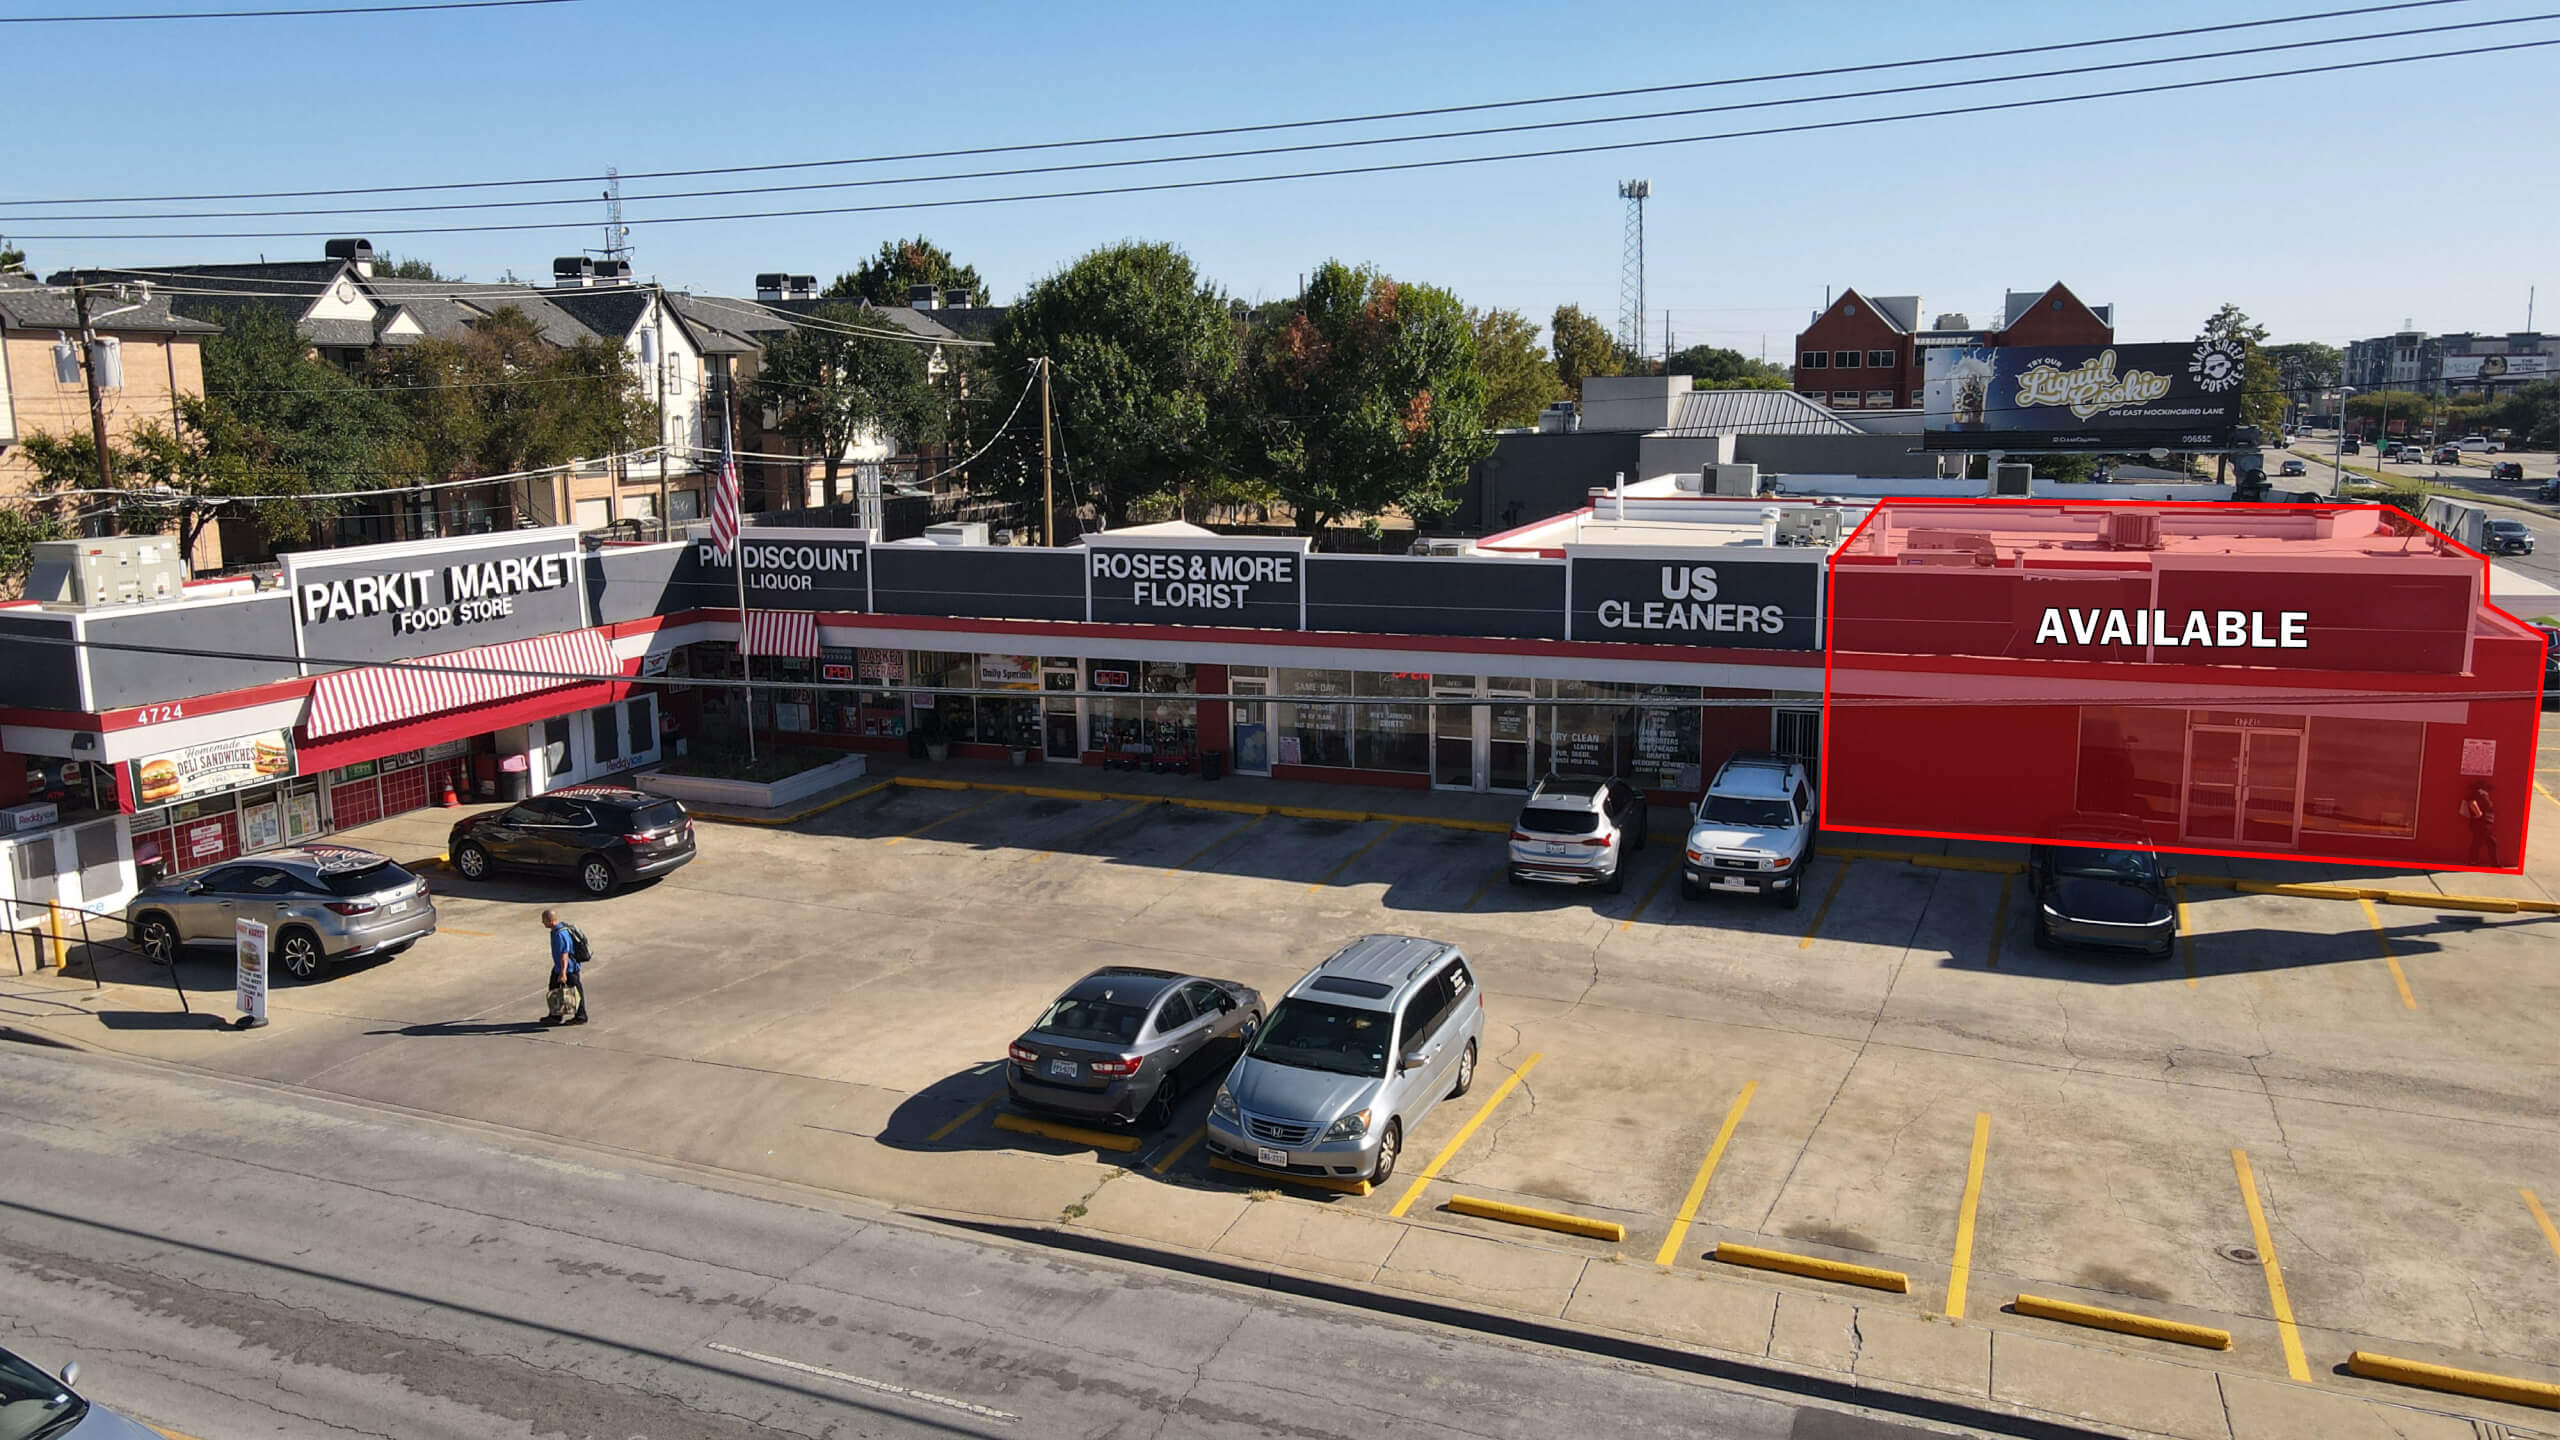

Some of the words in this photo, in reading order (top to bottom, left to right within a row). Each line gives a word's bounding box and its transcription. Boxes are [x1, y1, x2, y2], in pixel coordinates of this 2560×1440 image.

[2027, 358, 2043, 369] TRY
[2044, 357, 2062, 369] OUR
[2188, 342, 2214, 373] BLACK
[2214, 339, 2246, 360] SHEEP
[2016, 350, 2118, 407] Liquid
[2200, 370, 2244, 393] COFFEE
[2070, 369, 2172, 419] Cookie
[2143, 407, 2201, 416] MOCKINGBIRD
[2202, 407, 2225, 415] LANE
[743, 545, 863, 572] DISCOUNT
[1092, 552, 1185, 581] ROSES
[1188, 554, 1207, 580] &
[1210, 556, 1293, 583] MORE
[302, 568, 434, 623] PARKIT
[449, 551, 577, 602] MARKET
[750, 573, 813, 591] LIQUOR
[1133, 581, 1250, 610] FLORIST
[1661, 566, 1719, 602] US
[399, 606, 451, 632] FOOD
[459, 597, 514, 622] STORE
[1597, 599, 1785, 635] CLEANERS
[861, 648, 904, 664] MARKET
[982, 668, 1001, 679] Daily
[1002, 669, 1033, 680] Specials
[1295, 682, 1317, 691] SAME
[1320, 683, 1336, 692] DAY
[137, 703, 184, 725] 4724
[185, 740, 241, 758] Homemade
[1571, 732, 1600, 743] CLEAN
[177, 757, 198, 777] DELI
[200, 747, 257, 769] SANDWICHES
